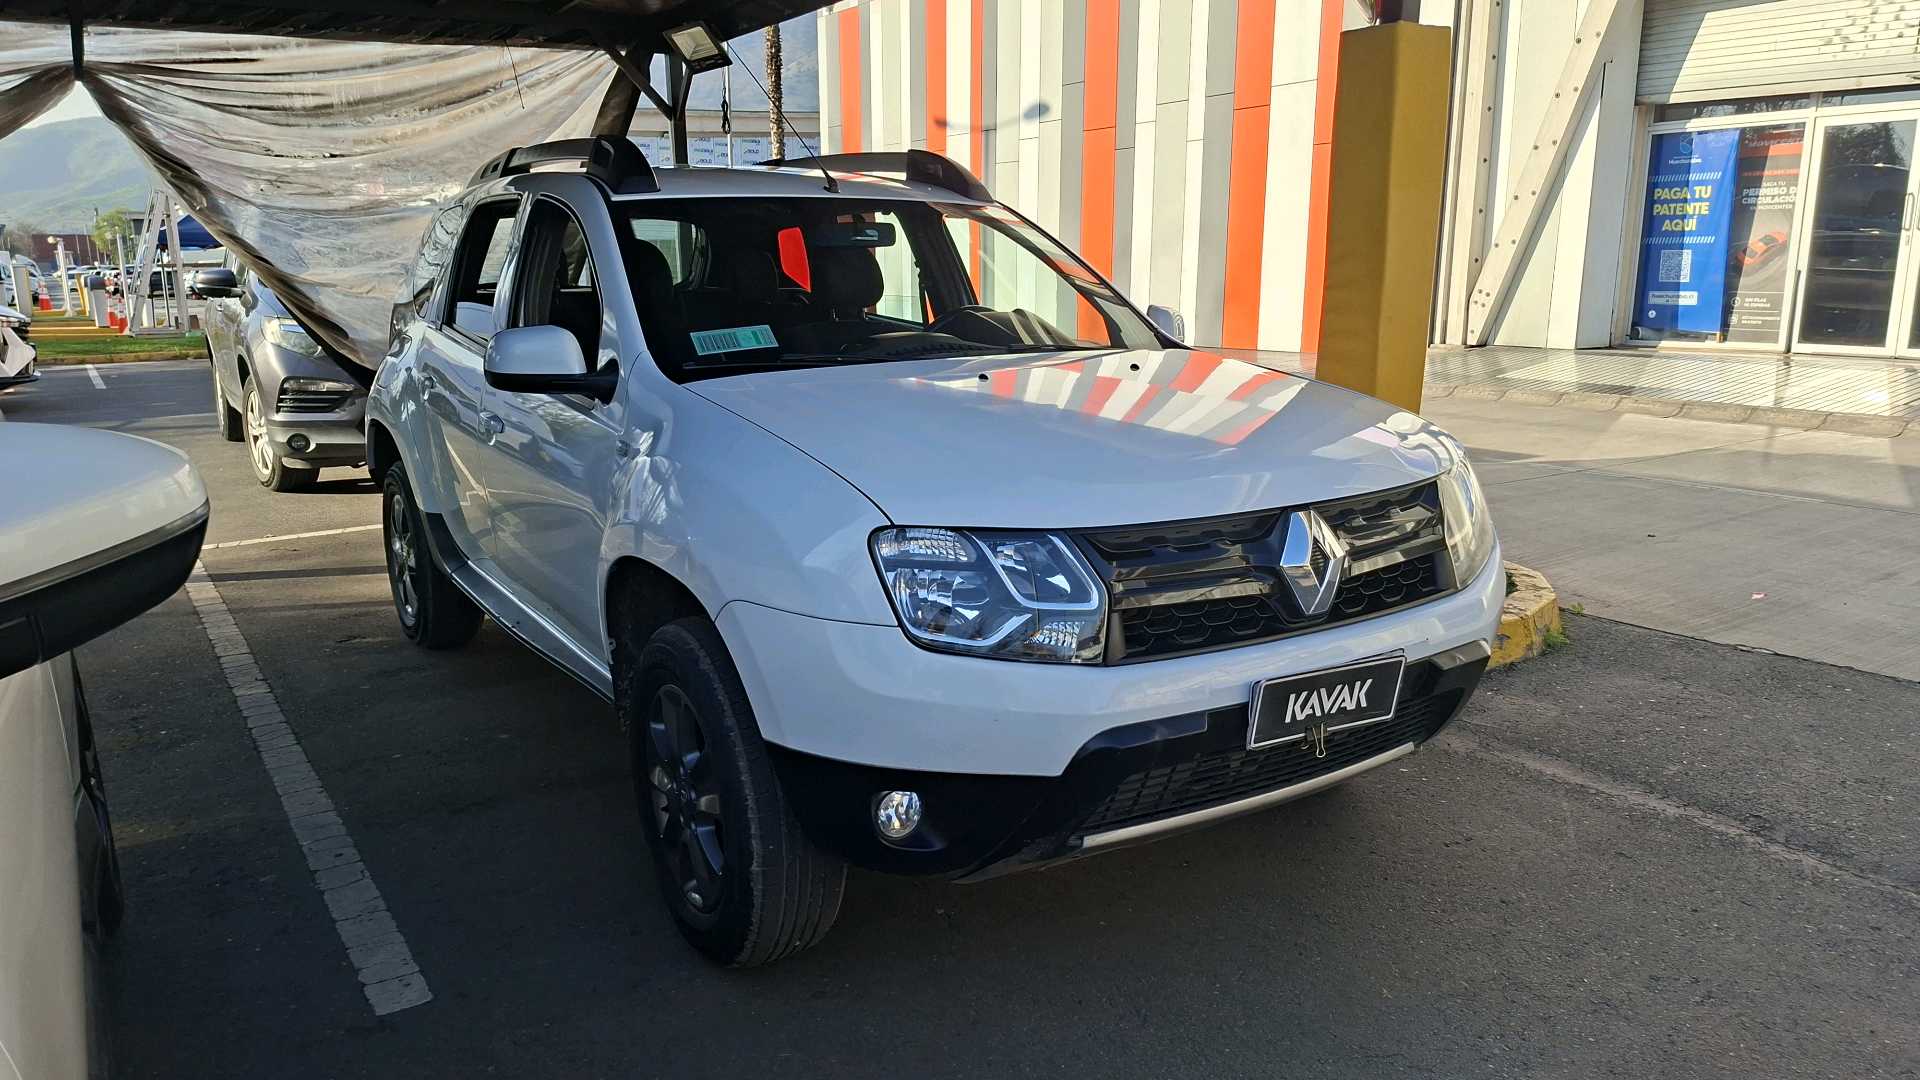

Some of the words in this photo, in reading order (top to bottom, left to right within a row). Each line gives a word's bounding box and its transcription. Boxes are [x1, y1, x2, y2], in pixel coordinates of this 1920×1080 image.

[1654, 186, 1690, 200] PAGA
[1694, 185, 1712, 199] TU
[1742, 194, 1797, 205] CIRCULACIÓ
[1653, 201, 1711, 216] PATENTE
[1662, 215, 1697, 231] AQUÍ
[1284, 678, 1374, 724] KAVAK
